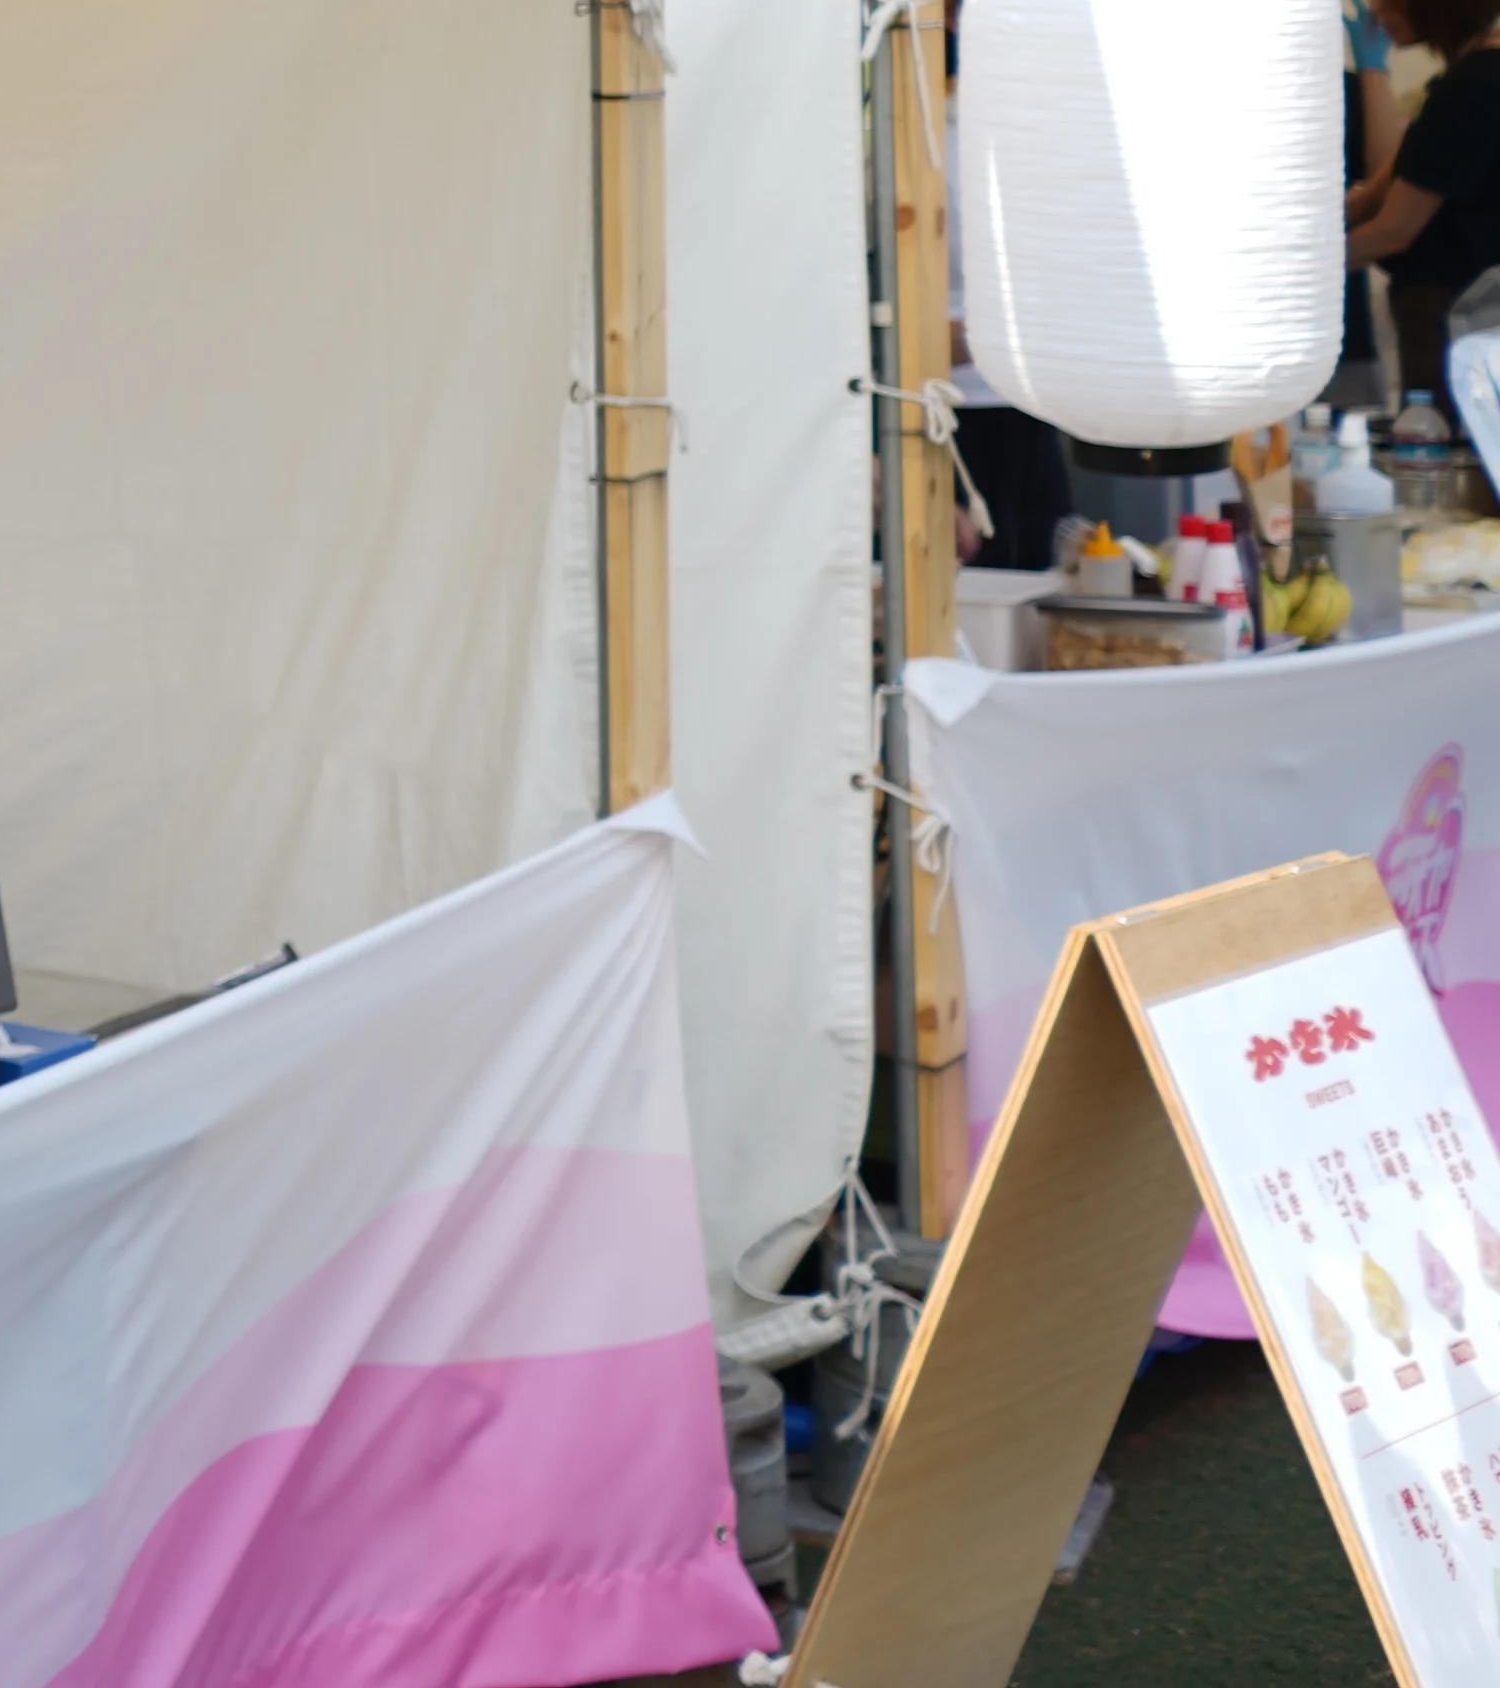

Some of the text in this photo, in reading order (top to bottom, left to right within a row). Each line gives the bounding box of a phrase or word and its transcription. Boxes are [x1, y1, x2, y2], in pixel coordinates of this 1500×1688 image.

[1245, 1006, 1376, 1082] かき氷
[1305, 1078, 1355, 1110] SWEETS
